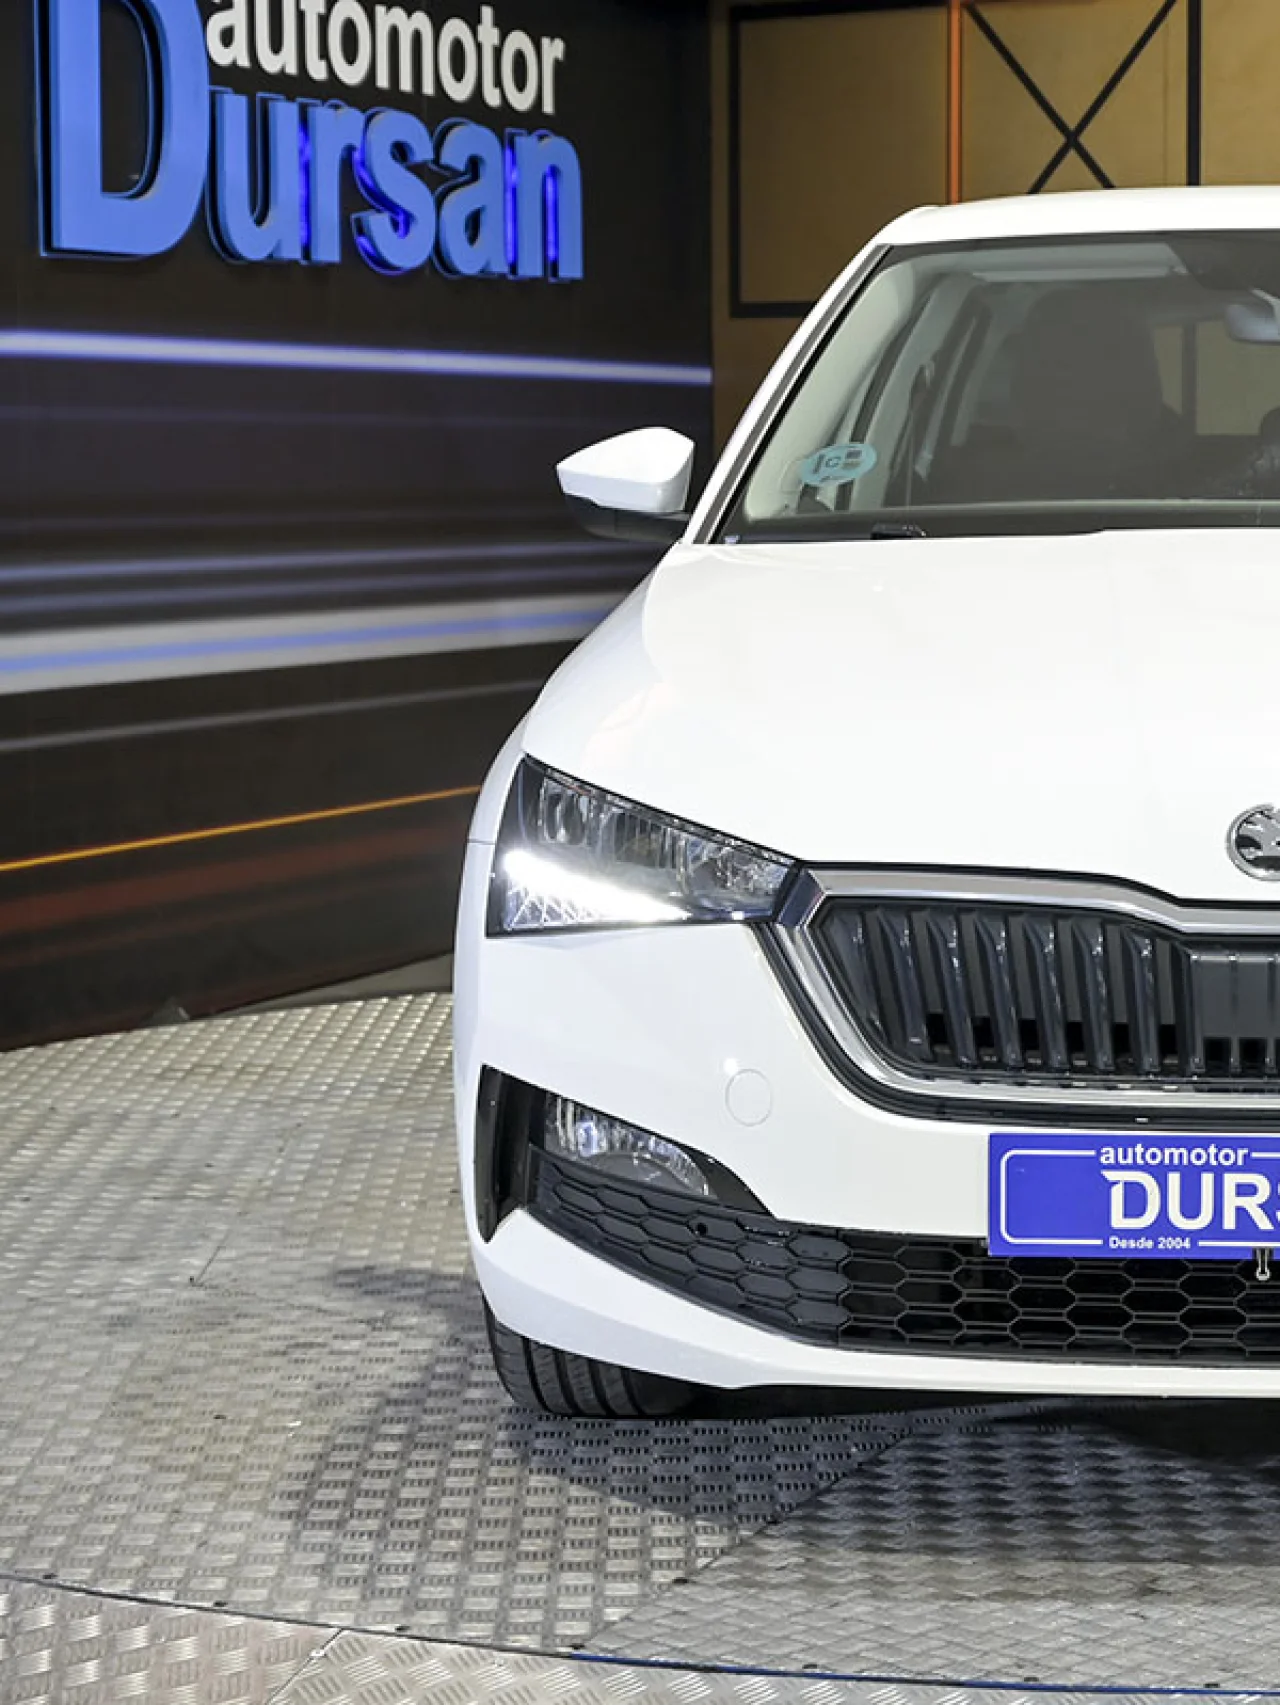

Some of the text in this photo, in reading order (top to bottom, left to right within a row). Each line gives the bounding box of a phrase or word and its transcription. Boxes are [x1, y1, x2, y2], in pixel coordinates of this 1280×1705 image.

[205, 0, 566, 114] automotor
[36, 0, 584, 281] Dursan
[1100, 1143, 1249, 1166] automotor
[1109, 1236, 1191, 1249] Desde 2004
